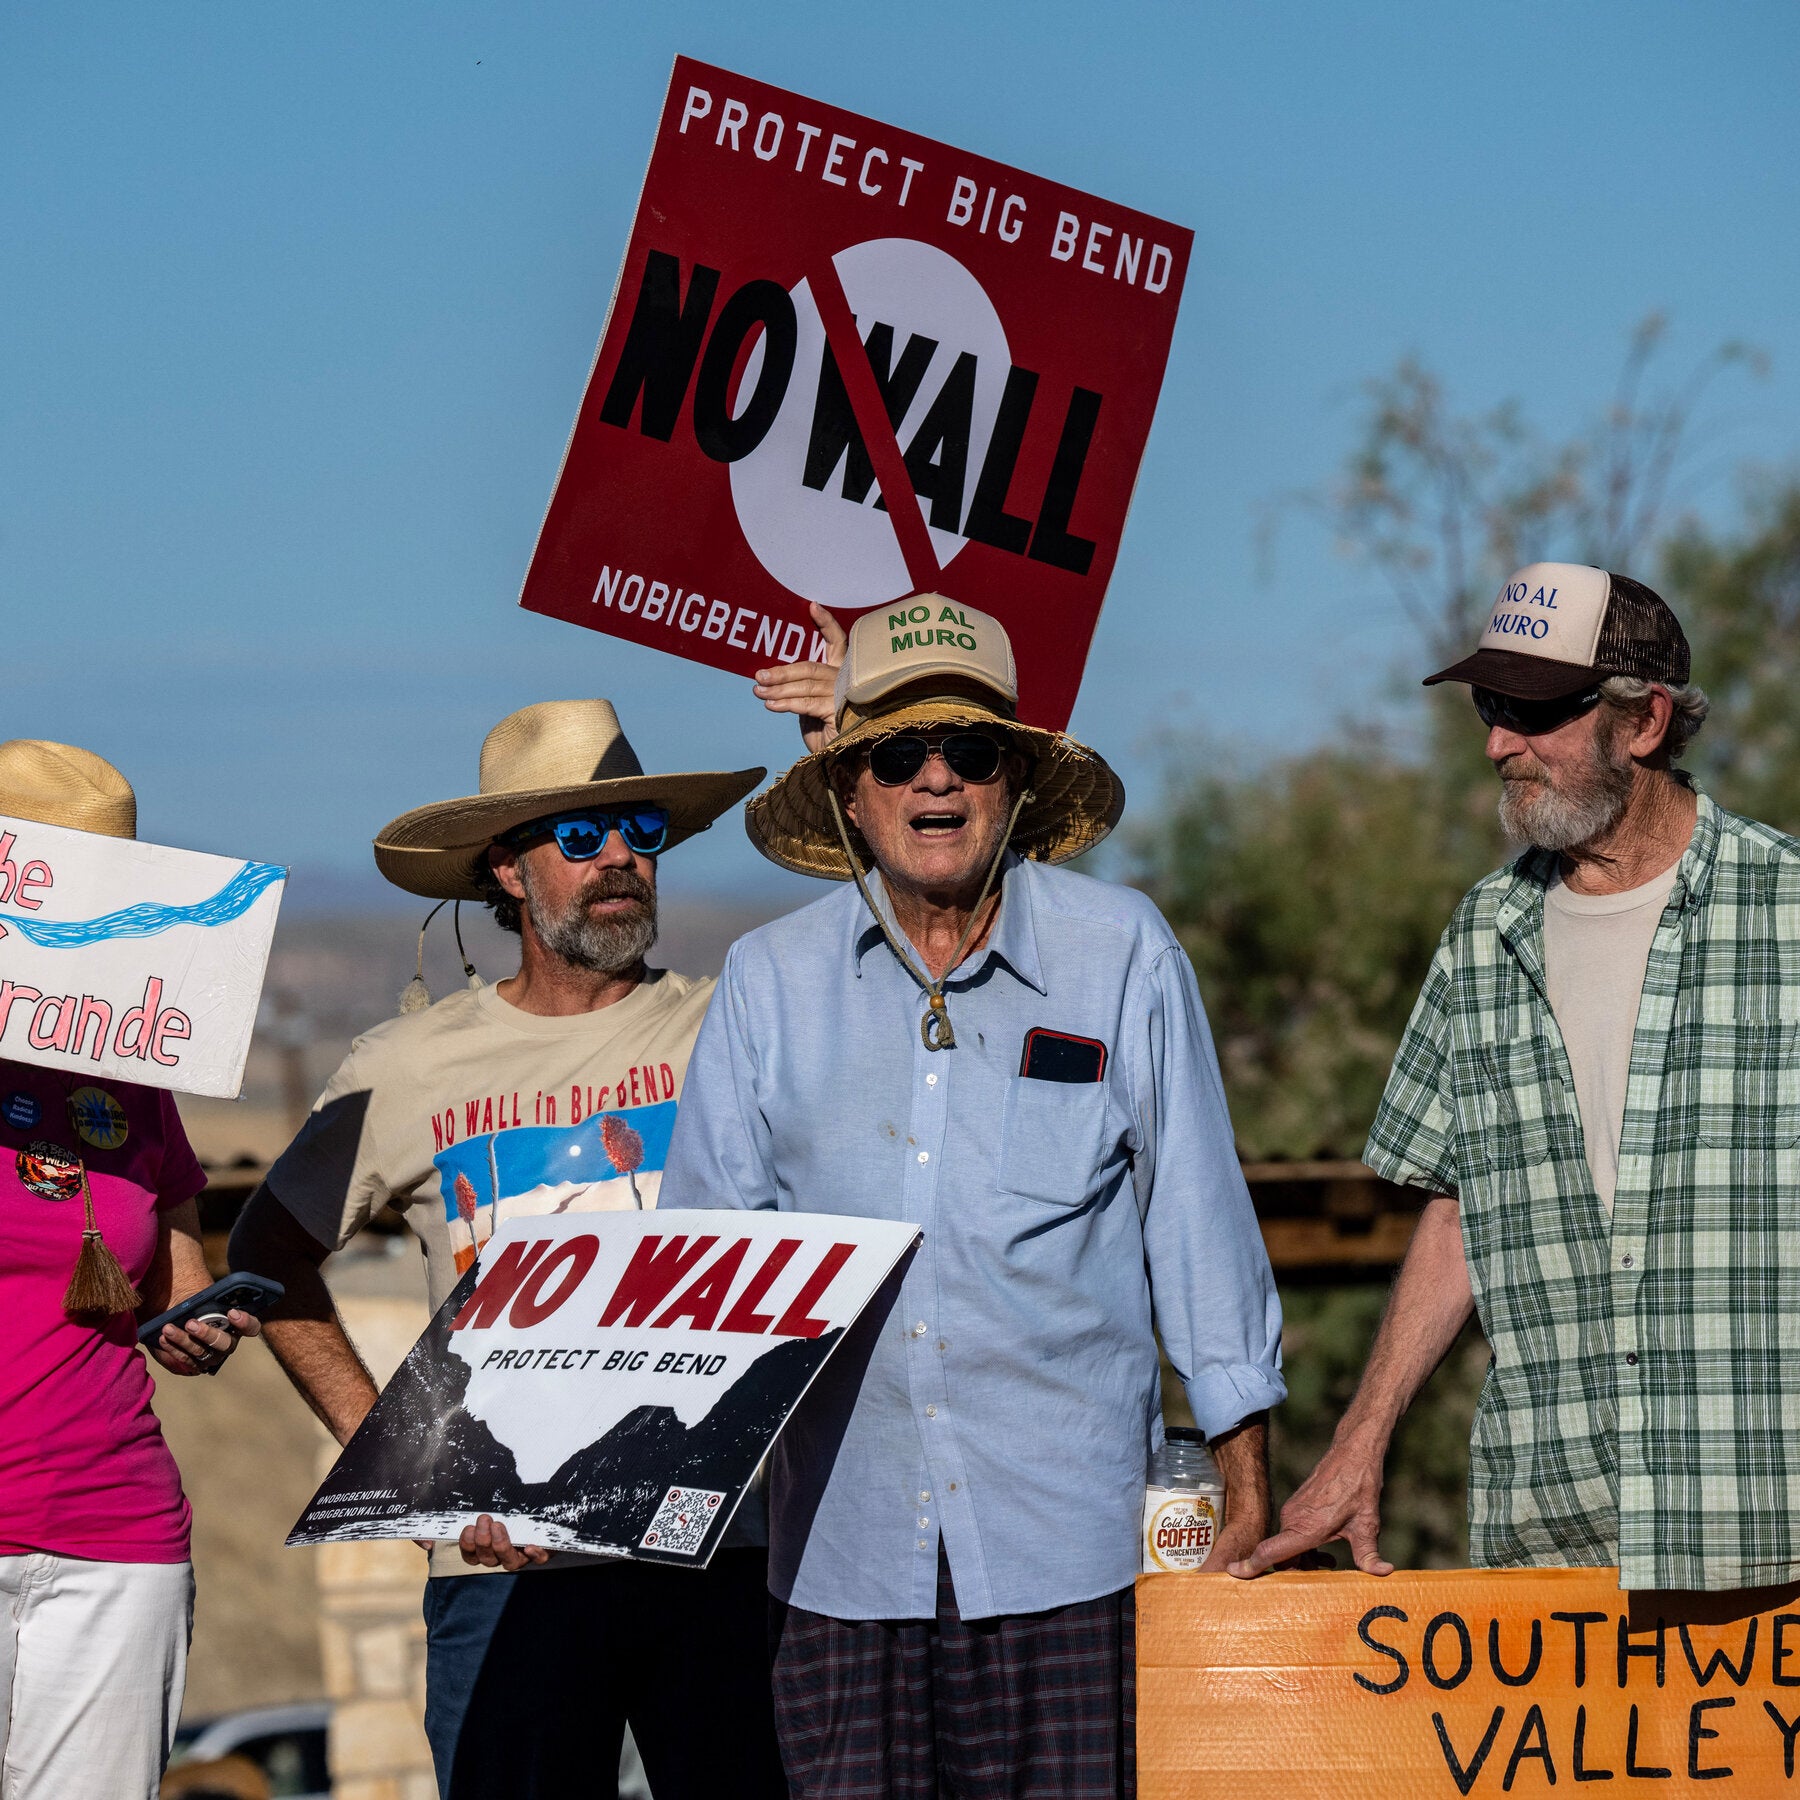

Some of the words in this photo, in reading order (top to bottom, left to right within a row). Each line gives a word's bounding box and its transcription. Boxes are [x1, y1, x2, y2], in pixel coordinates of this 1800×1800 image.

[679, 86, 923, 206] PROTECT
[946, 176, 1027, 243] BIG
[1050, 211, 1172, 294] BEND
[600, 249, 797, 463] NO
[802, 315, 1103, 576] WALL
[1501, 582, 1527, 603] NO
[1529, 585, 1559, 610] AL
[592, 565, 827, 664] NOBIGBENDW
[888, 606, 930, 630] NO
[938, 606, 975, 630] AL
[1488, 614, 1549, 639] MURO
[891, 629, 977, 653] MURO
[0, 830, 53, 910] he
[0, 974, 191, 1066] rande
[431, 1107, 455, 1153] NO
[466, 1092, 521, 1137] WALL
[536, 1090, 556, 1125] in
[28, 1140, 48, 1152] BIG
[49, 1143, 78, 1163] BEND
[35, 1151, 44, 1160] IS
[45, 1155, 70, 1168] WILD
[449, 1234, 600, 1331] NO
[598, 1235, 858, 1339] WALL
[481, 1348, 601, 1371] PROTECT
[603, 1350, 645, 1373] BIG
[654, 1353, 727, 1377] BEND
[316, 1489, 398, 1506] @NOBIGBENDWALL
[306, 1504, 407, 1521] NOBIGBENDWALL.ORG
[1161, 1516, 1183, 1528] Cold
[1184, 1515, 1208, 1528] Brew
[1157, 1526, 1212, 1549] COFFEE
[1166, 1547, 1205, 1557] CONCENTRATE
[1352, 1605, 1800, 1694] SOUTHWE
[1432, 1697, 1800, 1796] VALLEY
